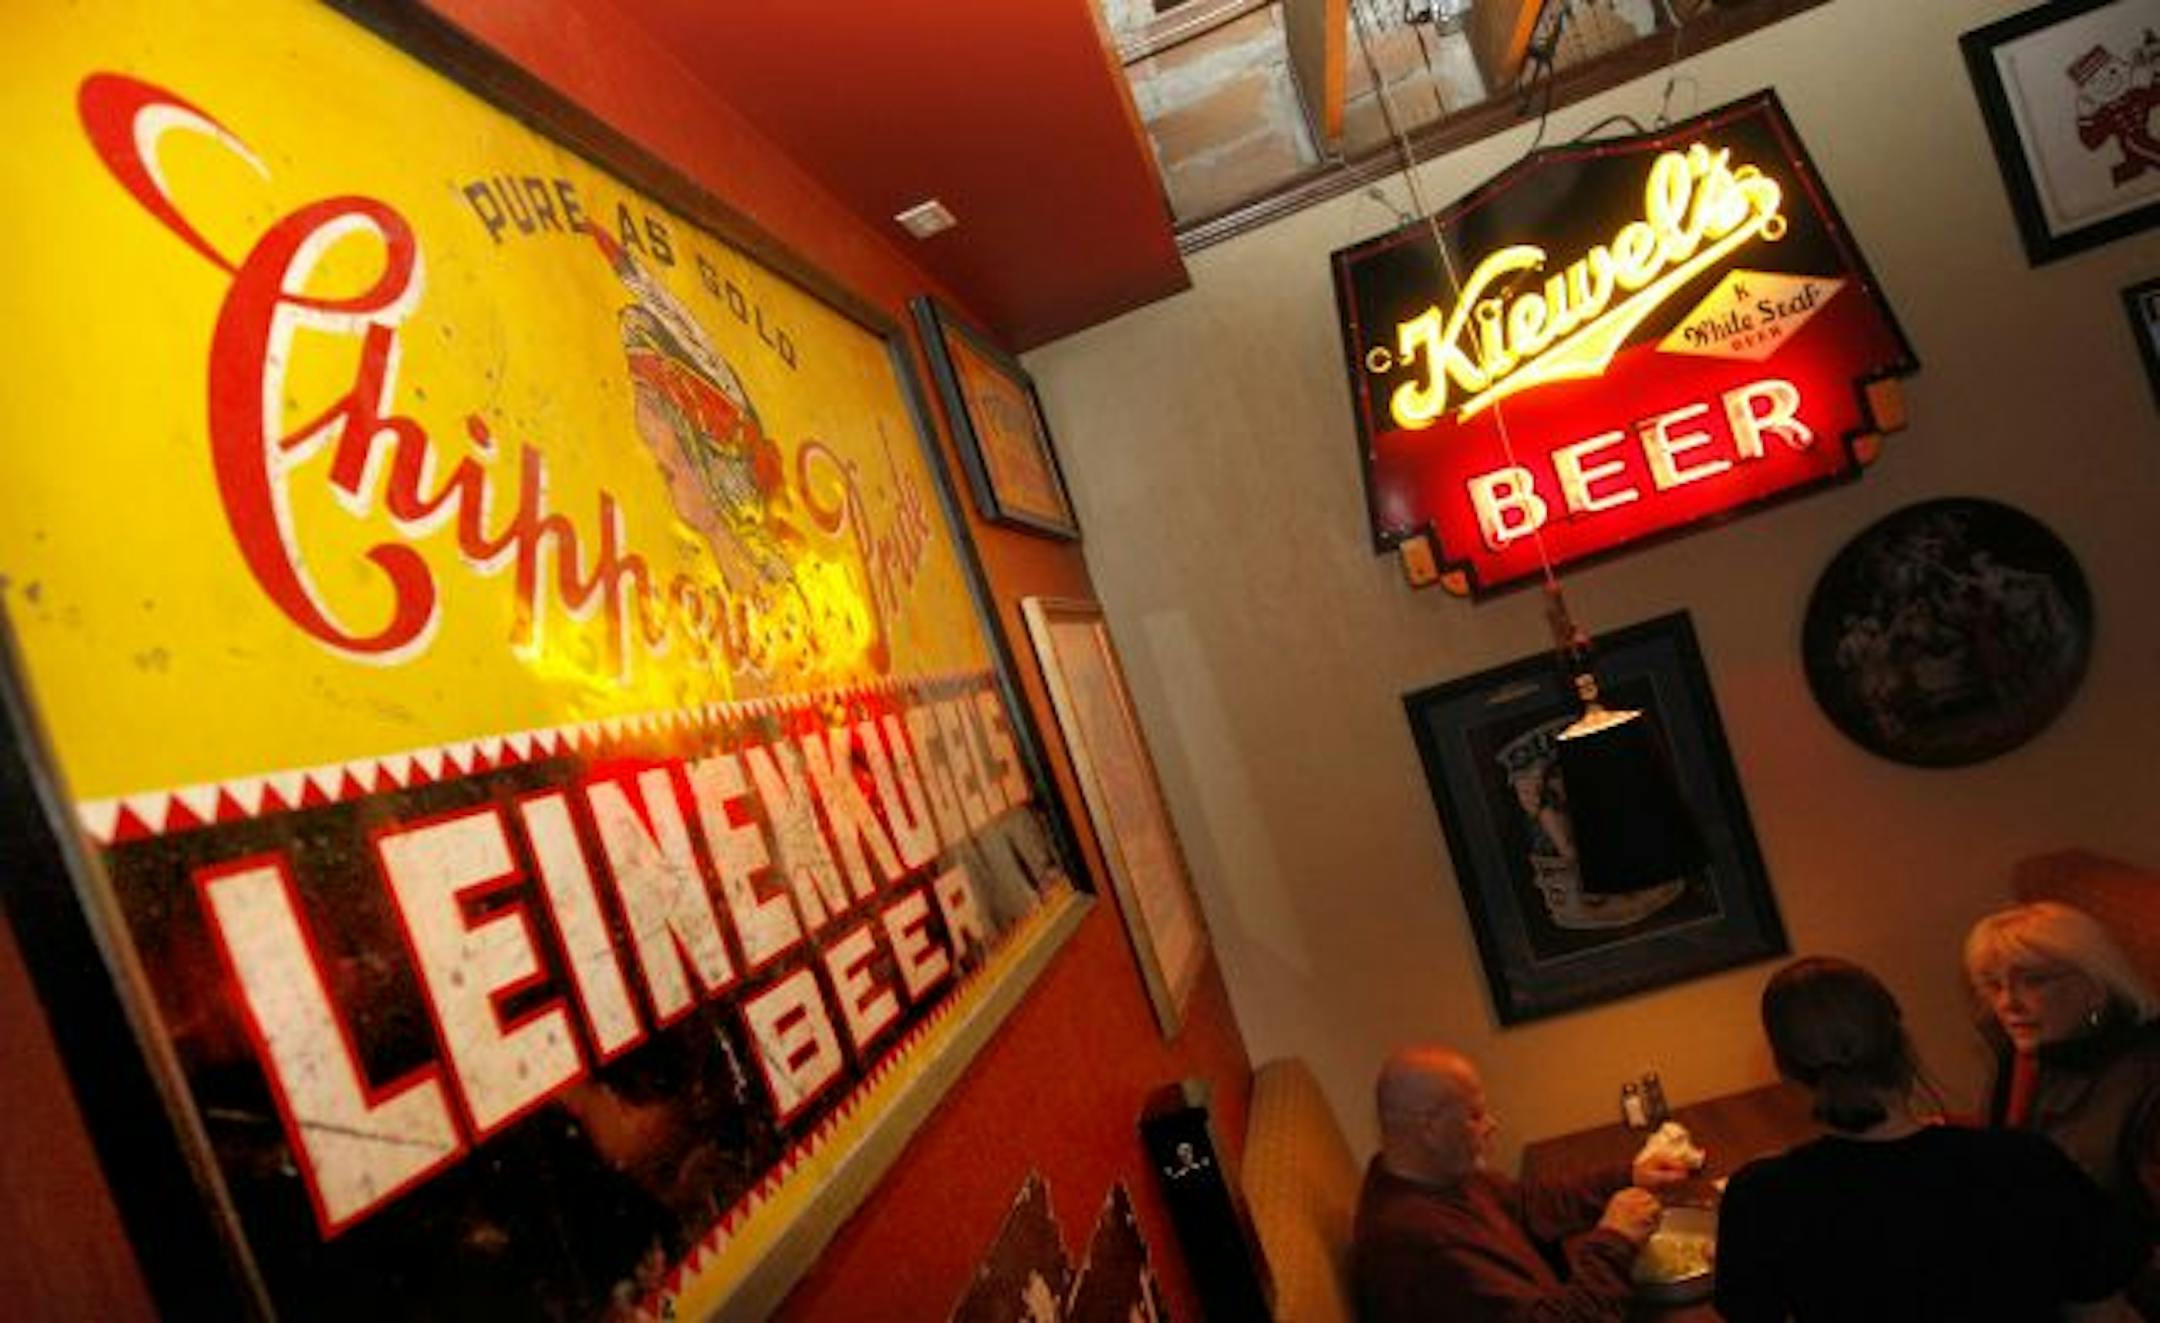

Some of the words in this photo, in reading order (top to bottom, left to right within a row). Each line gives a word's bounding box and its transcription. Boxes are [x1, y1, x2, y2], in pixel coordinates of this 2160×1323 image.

[462, 175, 588, 244] PURE
[617, 202, 676, 267] AS
[696, 255, 798, 371] GOLD
[1683, 308, 1751, 348] White
[1467, 379, 1814, 552] BEER
[743, 862, 988, 1123] BEER
